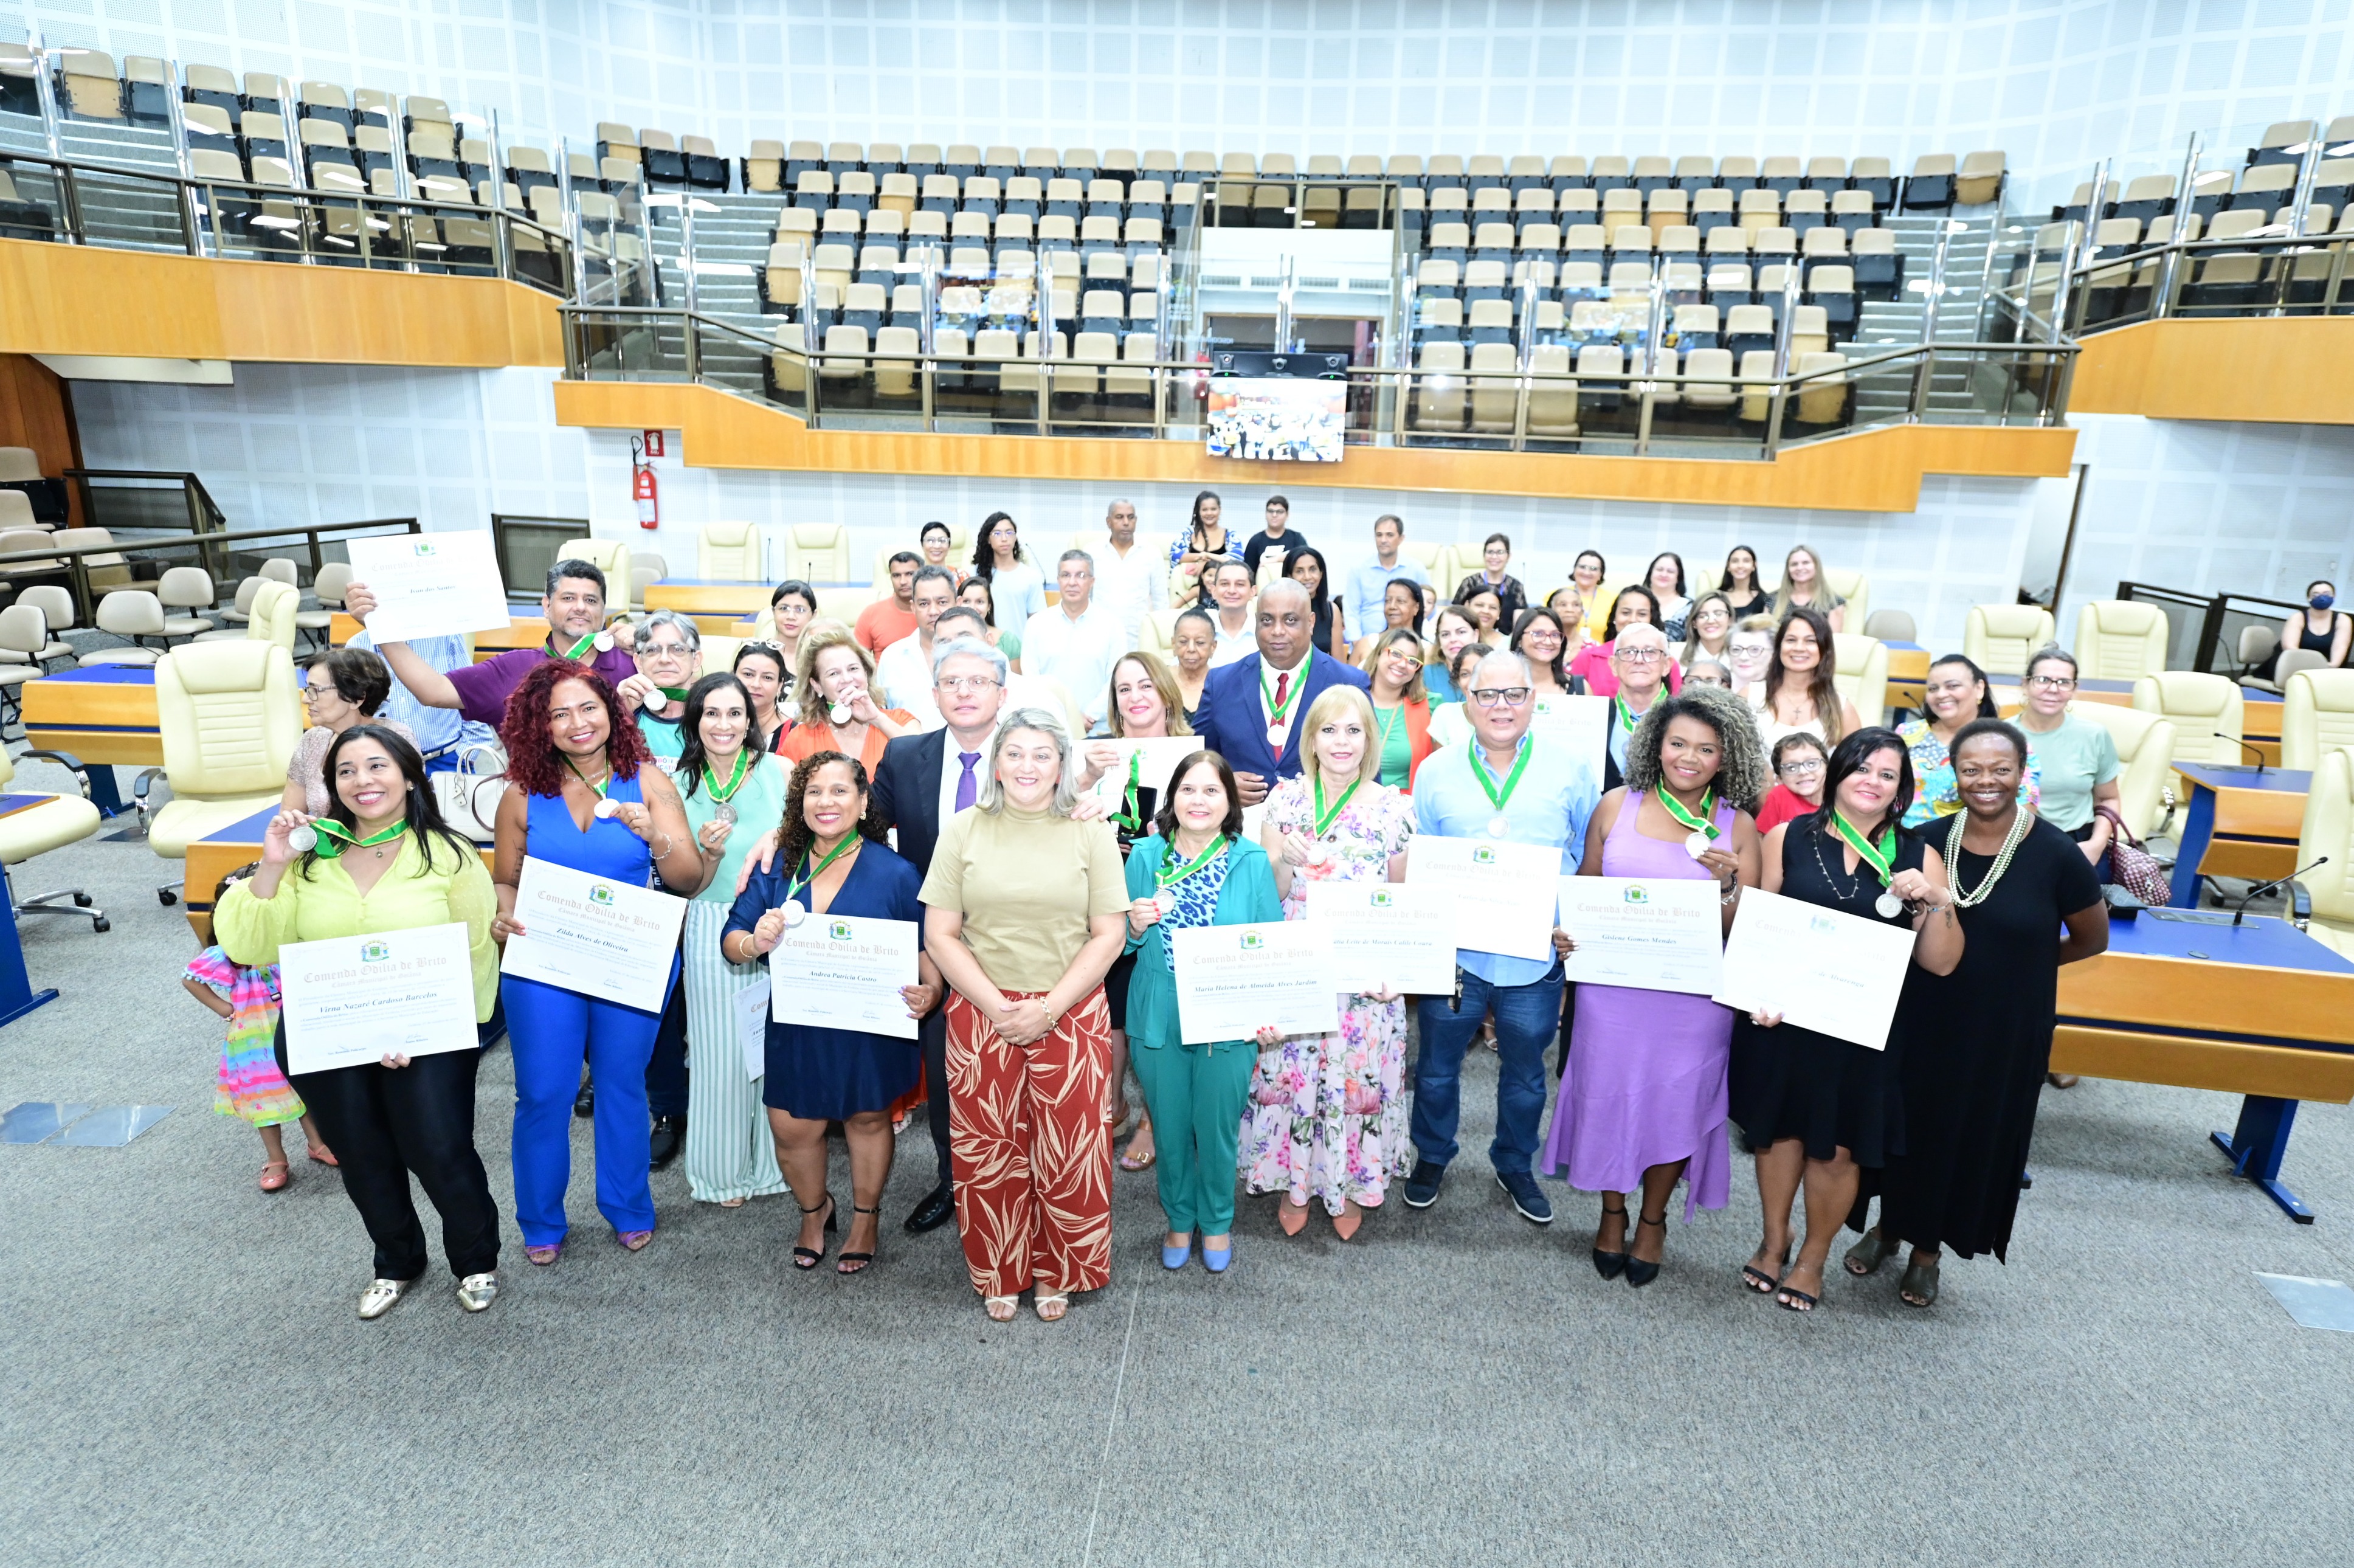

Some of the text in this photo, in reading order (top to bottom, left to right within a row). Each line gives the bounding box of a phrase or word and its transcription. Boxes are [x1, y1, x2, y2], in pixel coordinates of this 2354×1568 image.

[538, 891, 660, 930] Comenda Odília de Brito
[1577, 903, 1620, 913] Comenda
[1672, 907, 1700, 917] Brito
[576, 933, 592, 942] Alves
[603, 941, 628, 952] Oliveira
[785, 938, 899, 956] Comenda Odília de Brito
[304, 957, 446, 983] Comenda Odília de Brito
[343, 1000, 370, 1009] Nazaré
[406, 992, 437, 1001] Barcelos
[750, 1000, 768, 1013] Com
